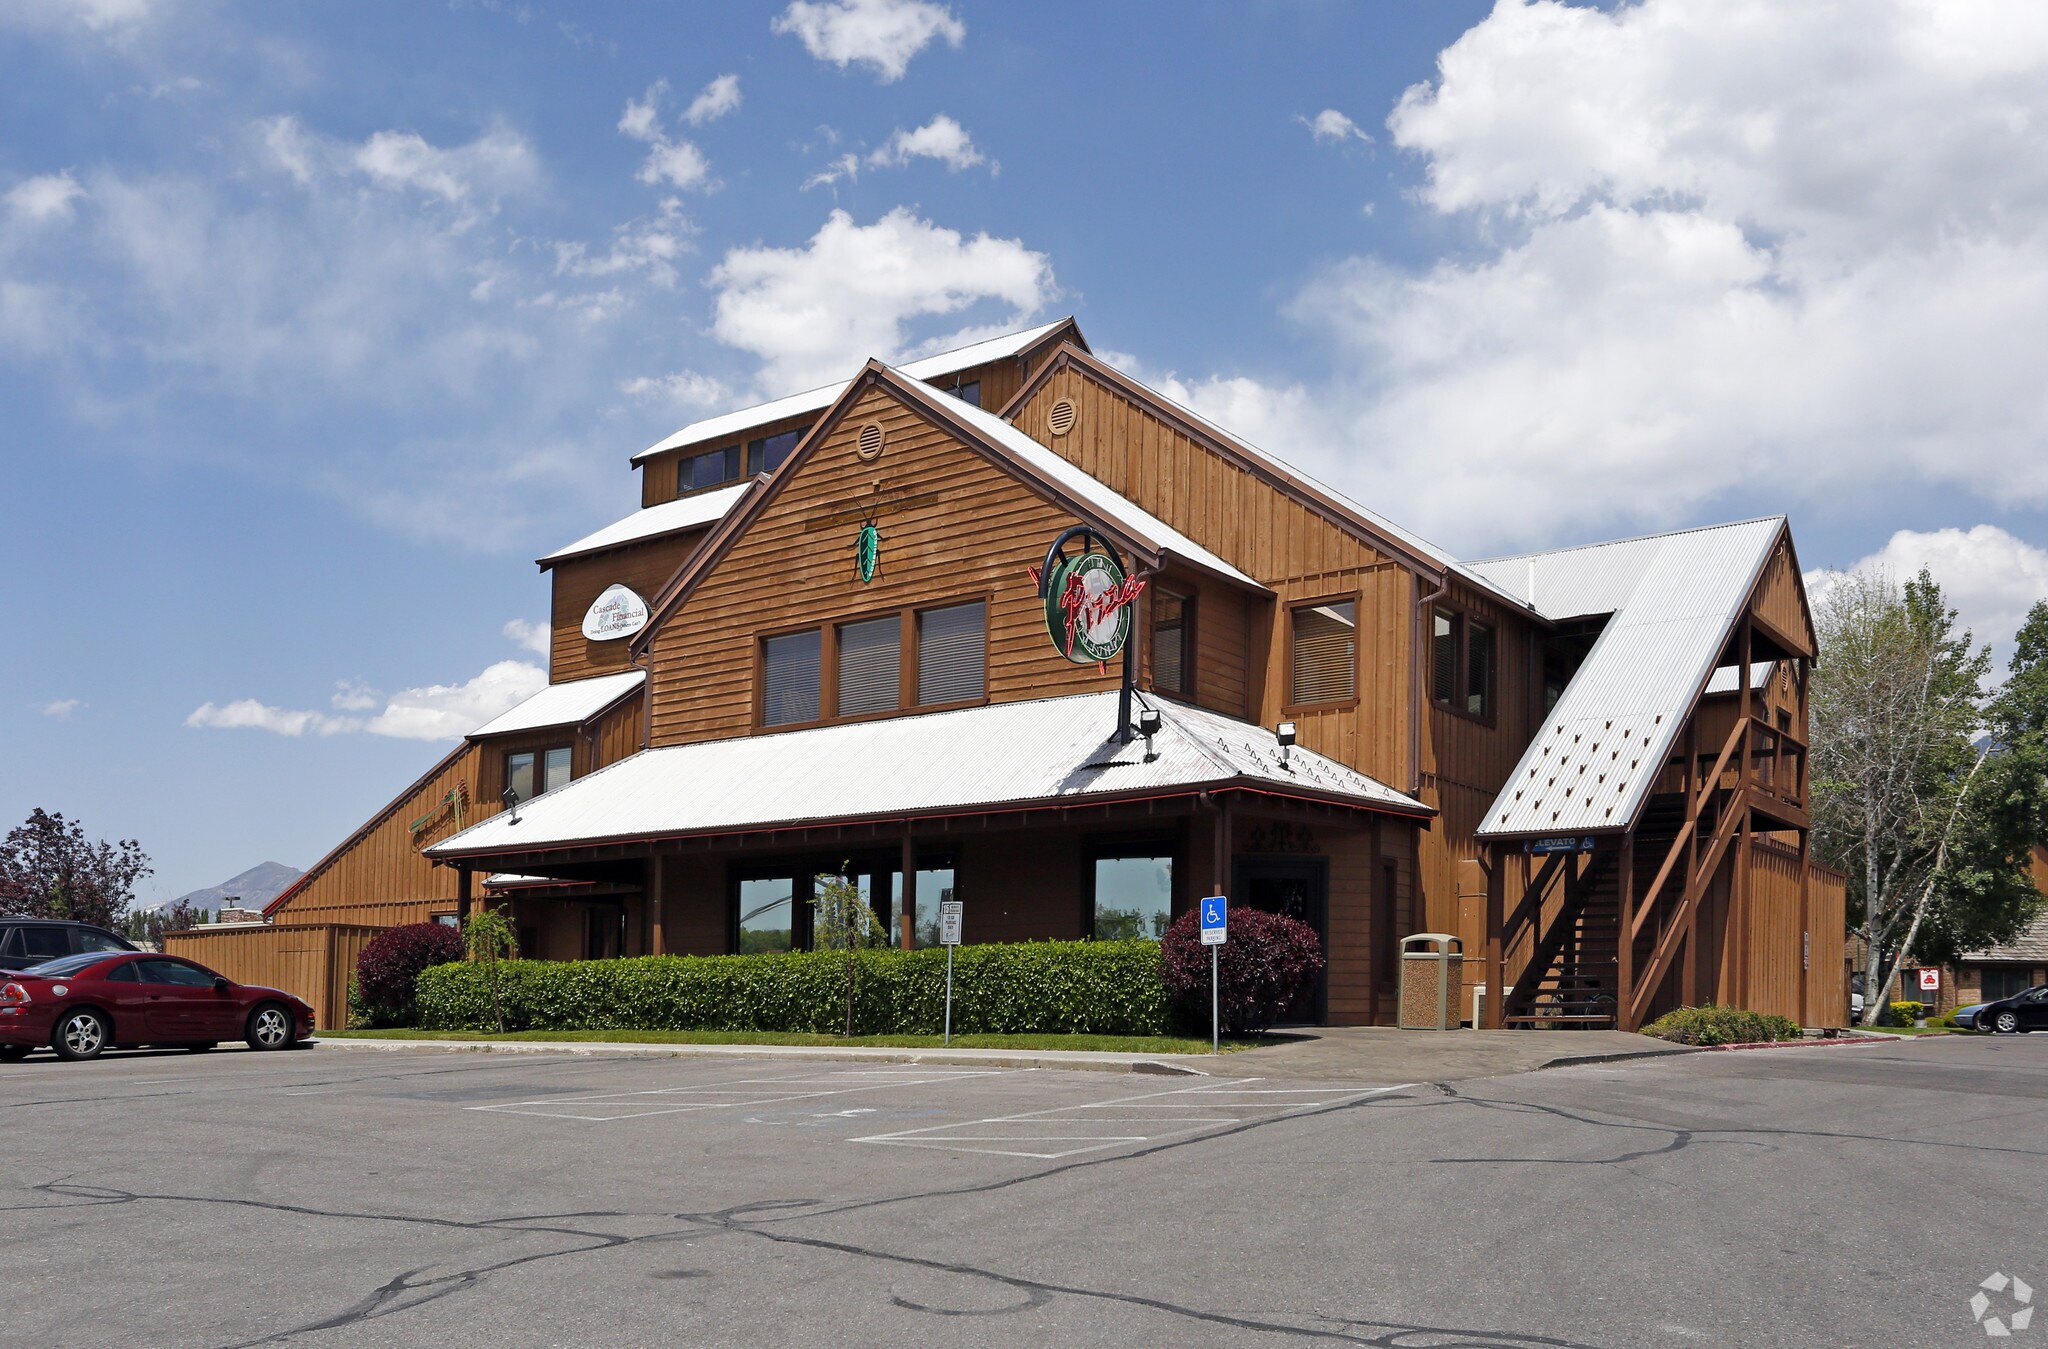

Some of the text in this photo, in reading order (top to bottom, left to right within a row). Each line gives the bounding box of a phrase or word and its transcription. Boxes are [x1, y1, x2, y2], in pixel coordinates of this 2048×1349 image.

[593, 601, 621, 615] Cascade
[612, 607, 644, 622] Financial
[1060, 572, 1146, 657] Pizza
[1535, 837, 1576, 847] LEVATO
